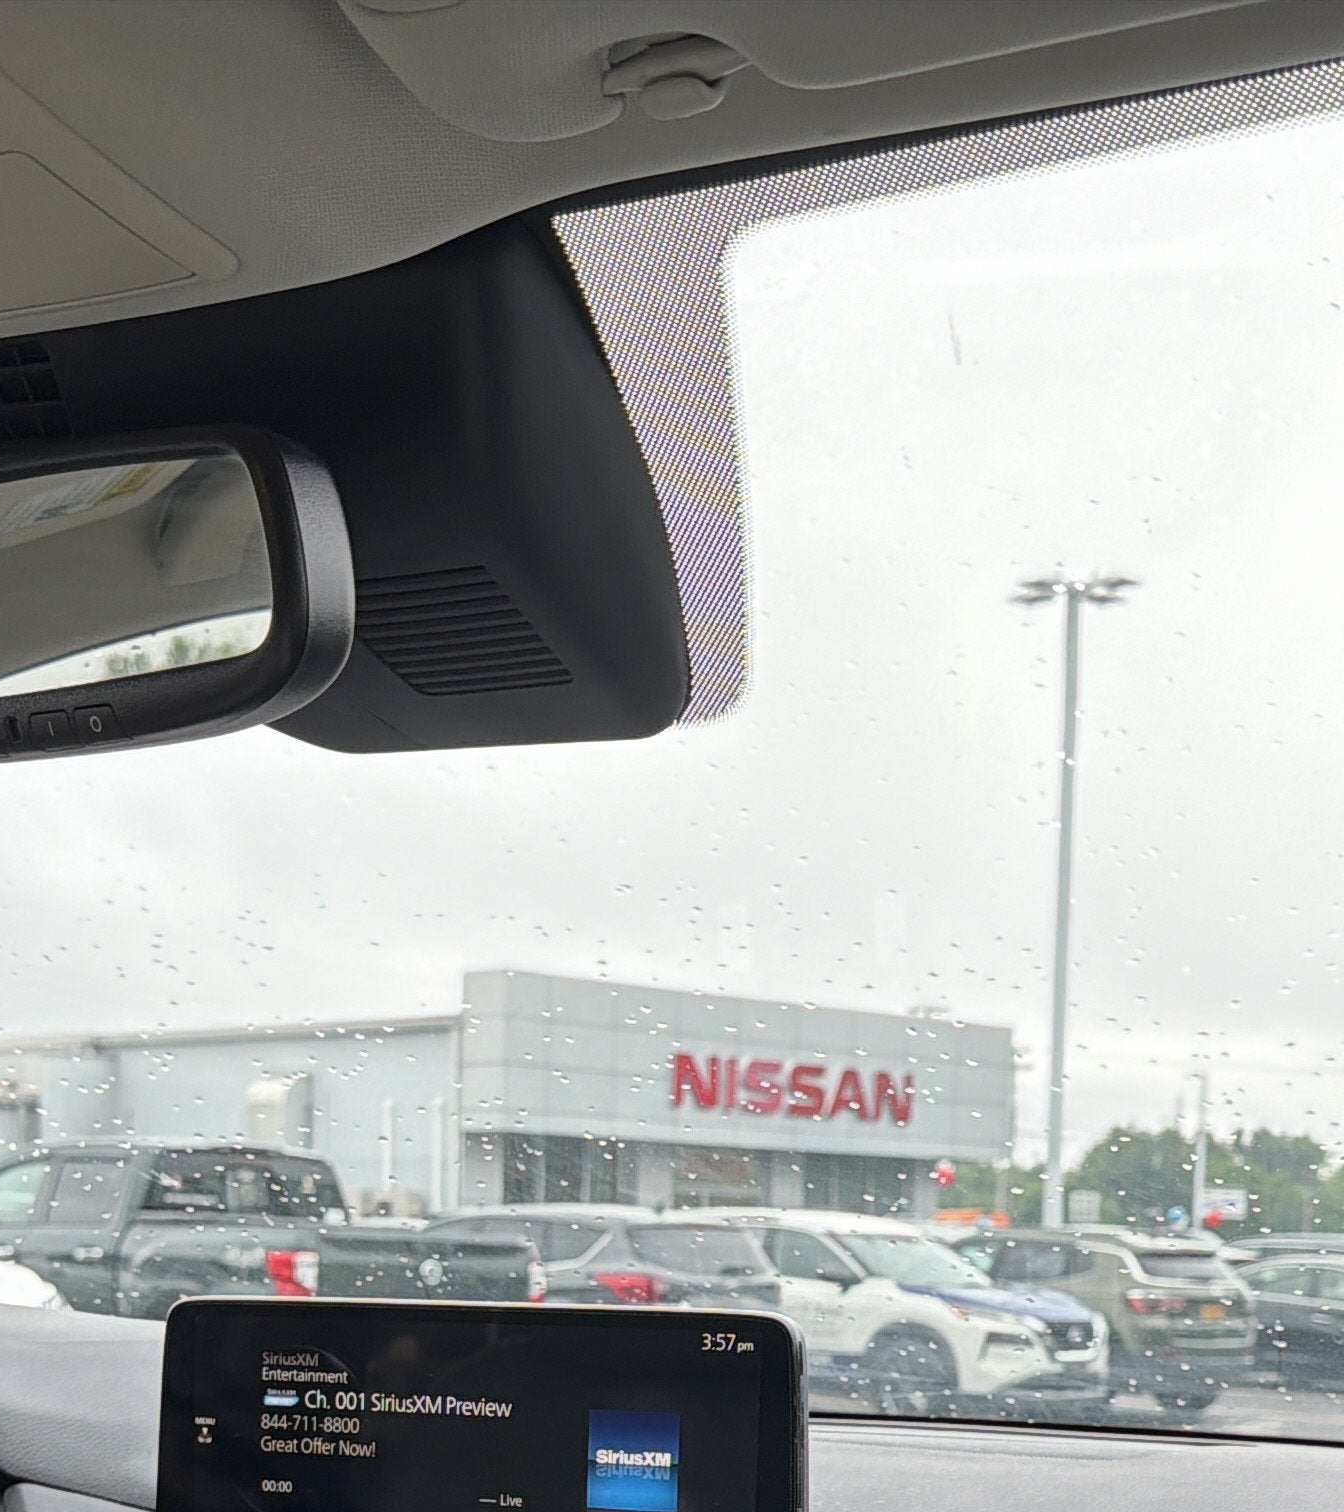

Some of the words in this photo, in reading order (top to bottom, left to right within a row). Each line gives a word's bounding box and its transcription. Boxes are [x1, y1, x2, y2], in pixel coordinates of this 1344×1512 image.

[671, 1052, 914, 1125] NISSAN
[262, 1352, 319, 1367] SiriusXM
[261, 1367, 348, 1384] Entertainment
[304, 1389, 331, 1409] Ch.
[335, 1391, 365, 1411] 001
[371, 1392, 442, 1414] SiriusXM
[446, 1396, 513, 1418] Preview
[260, 1413, 360, 1433] 844-711-8800
[260, 1435, 298, 1454] Great
[300, 1437, 336, 1455] Offer
[338, 1439, 376, 1457] Now!
[595, 1449, 672, 1467] SiriusXM
[261, 1479, 293, 1493] 00:00
[500, 1493, 523, 1507] Live
